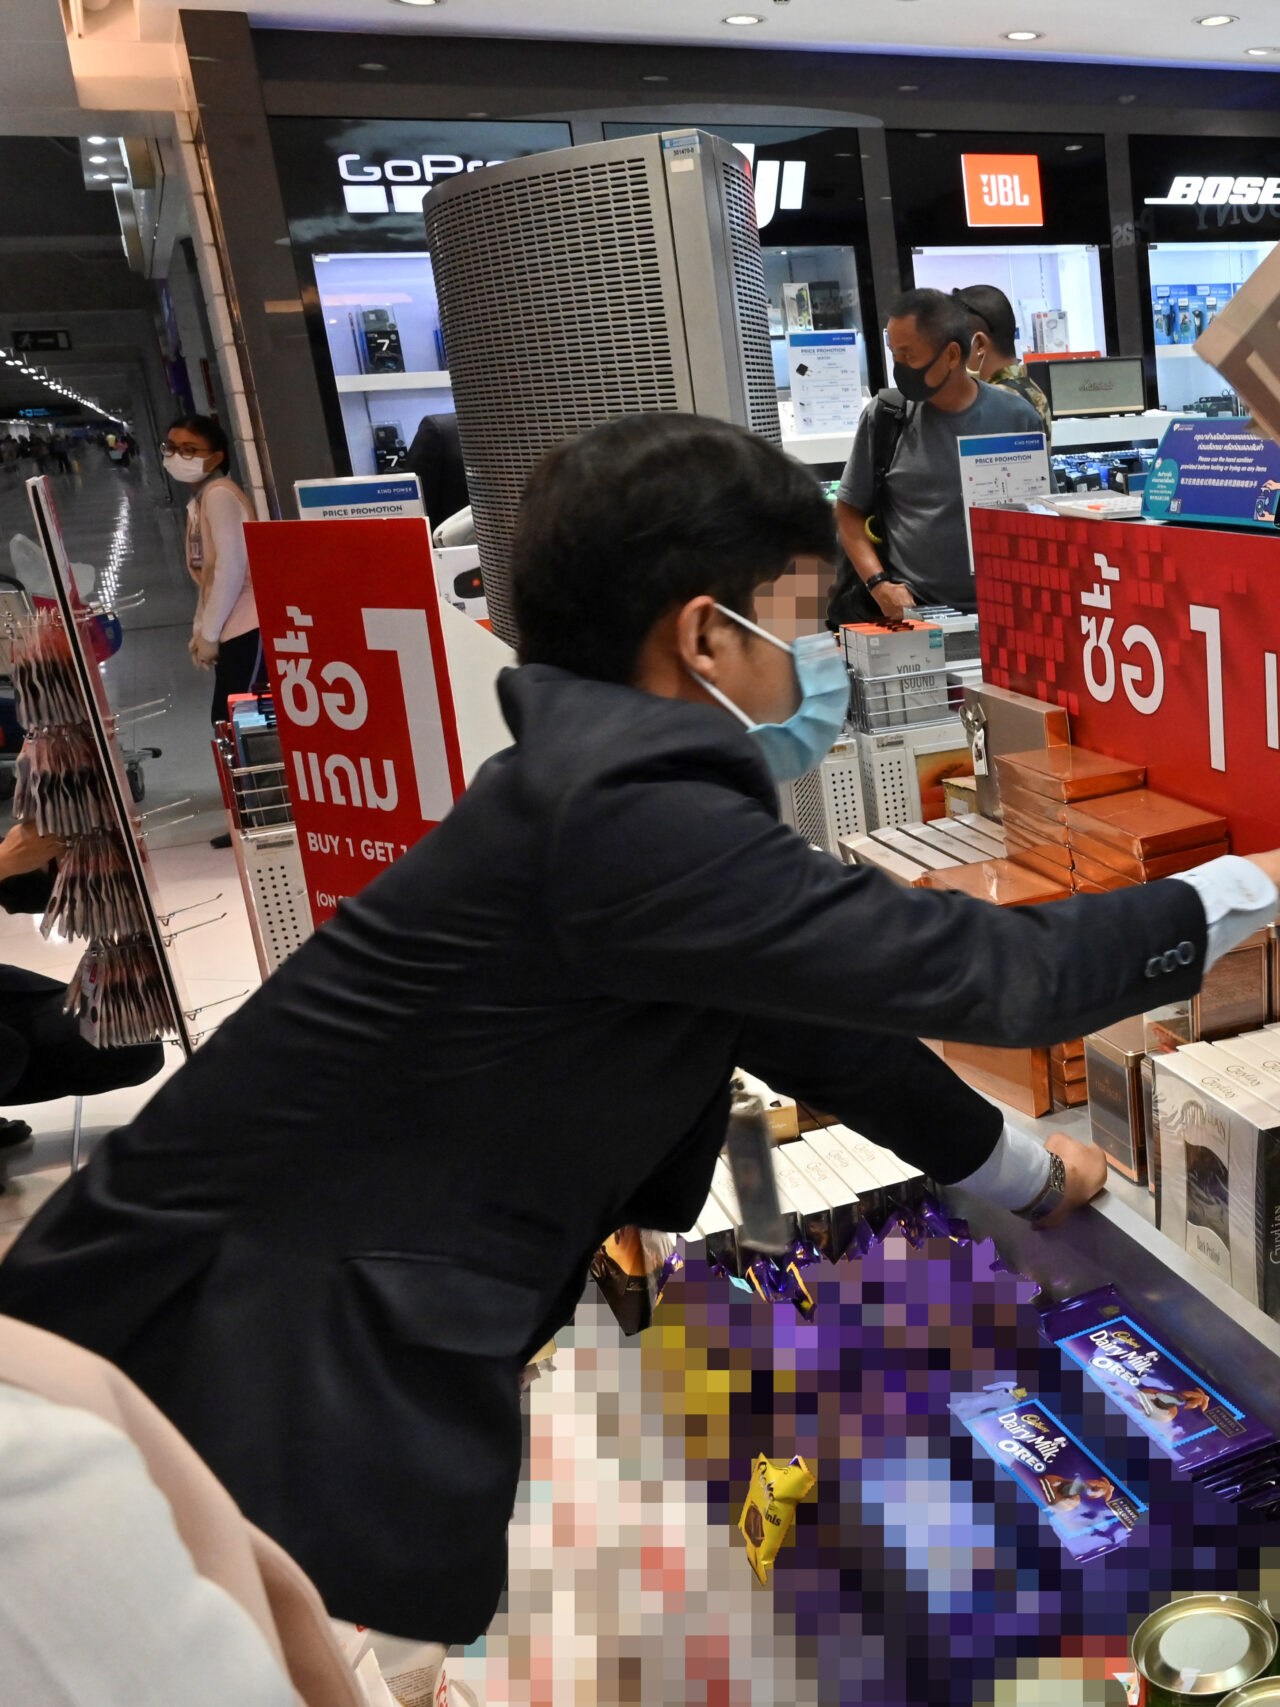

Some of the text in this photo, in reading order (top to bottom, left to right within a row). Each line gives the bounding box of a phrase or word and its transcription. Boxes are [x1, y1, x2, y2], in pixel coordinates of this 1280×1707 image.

[980, 174, 1030, 206] JBL
[377, 339, 390, 351] 7
[386, 455, 399, 467] 7
[975, 454, 1032, 465] PRICE PROMOTION
[322, 505, 403, 518] PRICE PROMOTION
[273, 605, 369, 731] ซื้อ
[1080, 552, 1165, 715] ซื้อ
[1189, 603, 1226, 773] 1
[903, 675, 935, 689] SOUND
[291, 750, 399, 812] แถม
[306, 832, 395, 863] BUY 1 GET
[1089, 1329, 1153, 1377] Dairy Milk
[1091, 1357, 1141, 1387] OREO
[998, 1412, 1060, 1463] Dairy Milk
[998, 1440, 1045, 1473] OREO
